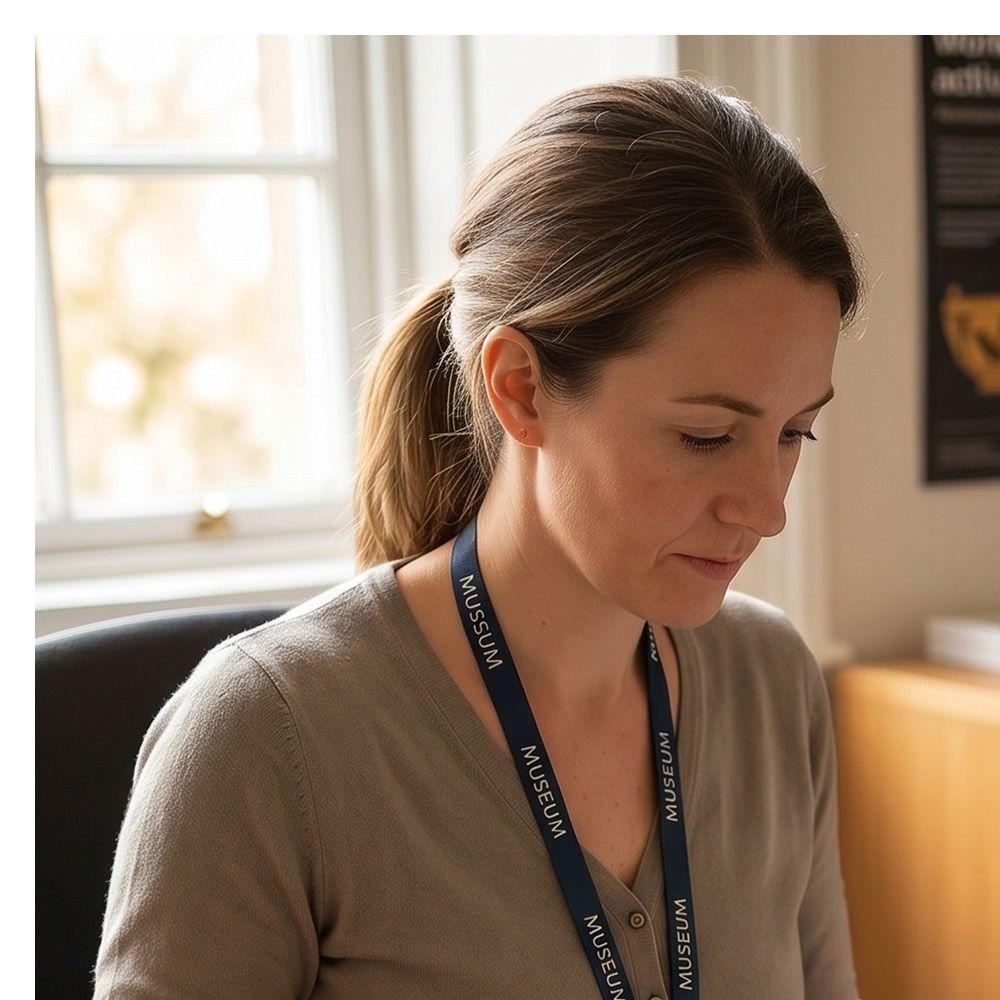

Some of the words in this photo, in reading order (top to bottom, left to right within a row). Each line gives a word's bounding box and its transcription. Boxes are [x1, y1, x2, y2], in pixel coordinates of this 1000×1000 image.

[521, 745, 567, 839] MUSEUM
[659, 732, 678, 822] MUSEUM
[674, 898, 693, 990] MUSEUM
